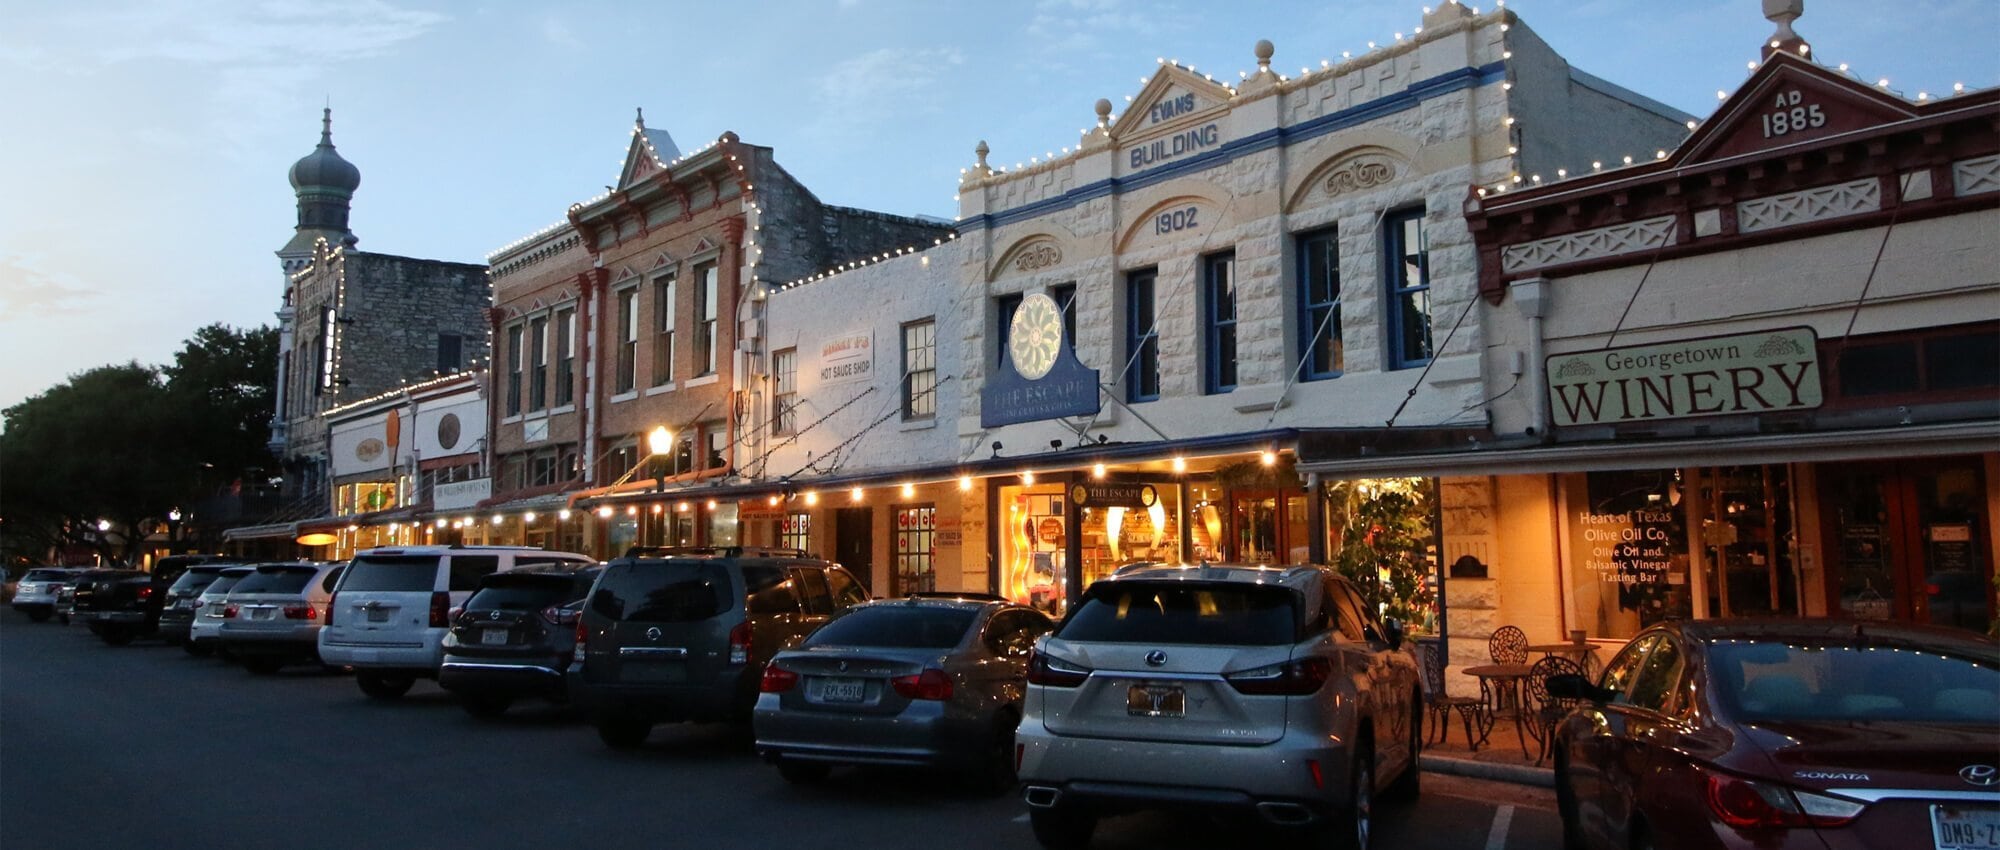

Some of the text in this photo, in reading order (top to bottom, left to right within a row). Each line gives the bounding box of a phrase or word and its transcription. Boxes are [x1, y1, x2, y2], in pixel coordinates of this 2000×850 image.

[1151, 93, 1195, 123] EVANS
[1776, 90, 1802, 108] AD
[1762, 104, 1825, 138] 1885
[1130, 124, 1218, 168] BUILDING
[1155, 206, 1198, 235] 1902
[1605, 345, 1740, 371] Georgetown
[820, 360, 870, 380] HOT SAUCE SHOP
[993, 380, 1084, 408] THE ESCAPE
[1553, 361, 1814, 423] WINERY
[1090, 487, 1107, 497] THE
[1580, 510, 1672, 524] Heart of Texas
[1584, 528, 1617, 541] Olive
[1622, 528, 1641, 540] Oil
[1593, 547, 1619, 557] Olive
[1643, 547, 1661, 557] and
[1585, 560, 1671, 570] Balsamic Vinegar
[1601, 572, 1656, 583] Tasting Bar
[1793, 771, 1870, 781] SONATA
